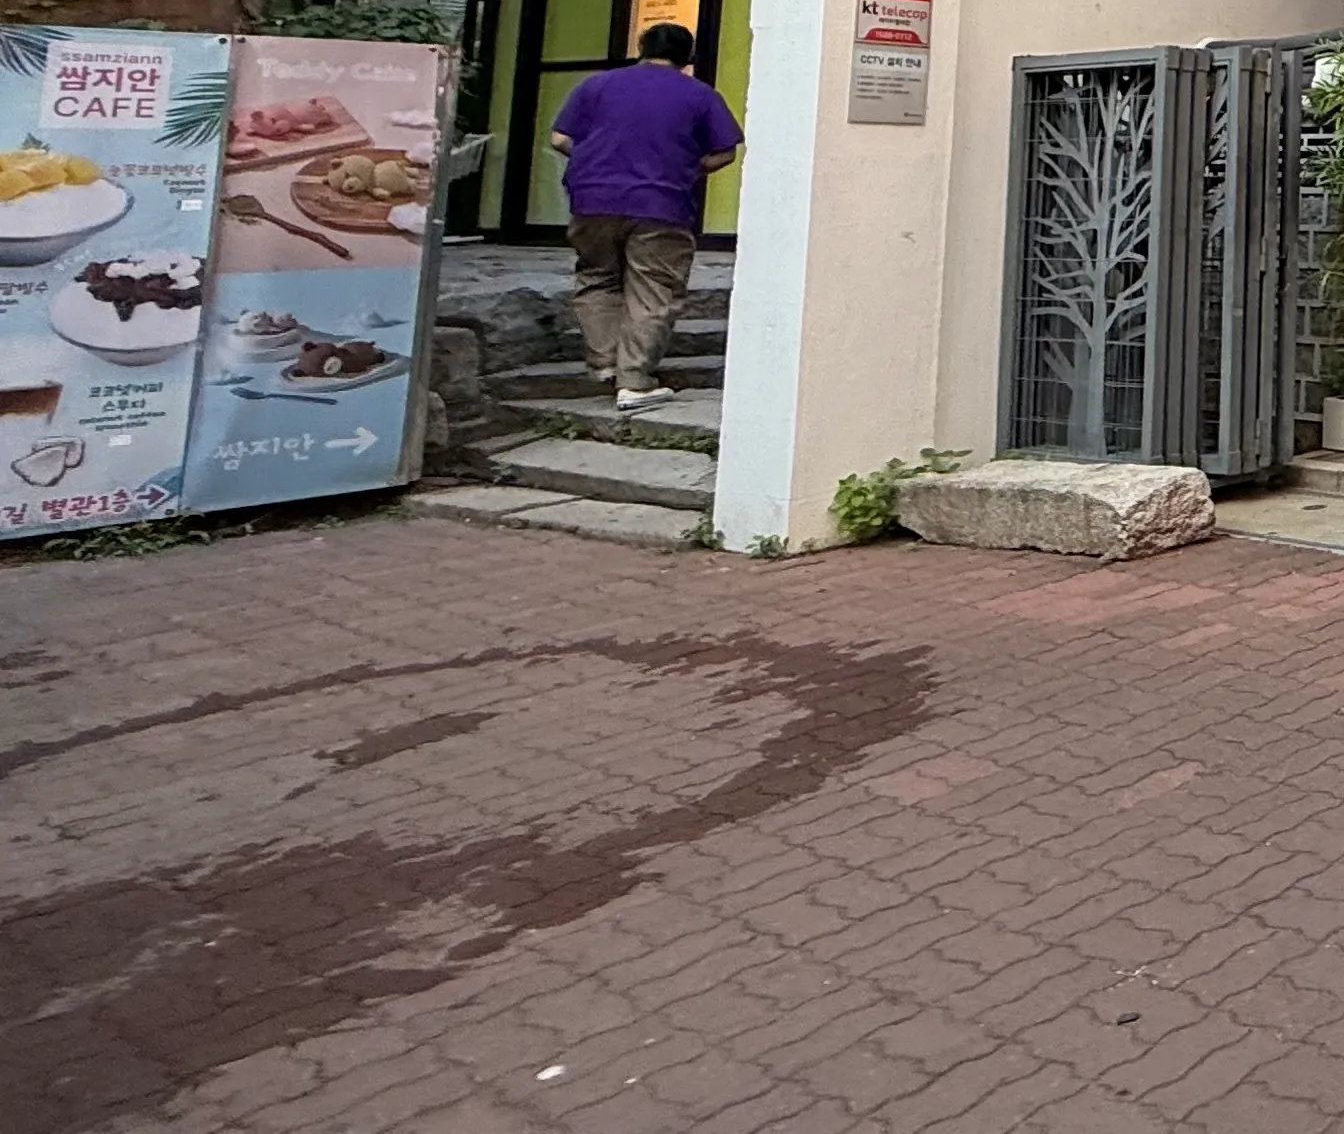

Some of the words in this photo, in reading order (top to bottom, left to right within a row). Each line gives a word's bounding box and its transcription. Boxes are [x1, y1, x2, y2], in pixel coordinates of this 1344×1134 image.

[862, 0, 879, 15] kt
[882, 5, 928, 21] telecop
[860, 54, 884, 66] CCTV
[56, 66, 161, 93] 쌈지안
[54, 97, 157, 118] CAFE
[213, 433, 316, 471] 쌈지안
[0, 503, 29, 525] 길
[41, 489, 132, 520] 별관1층
